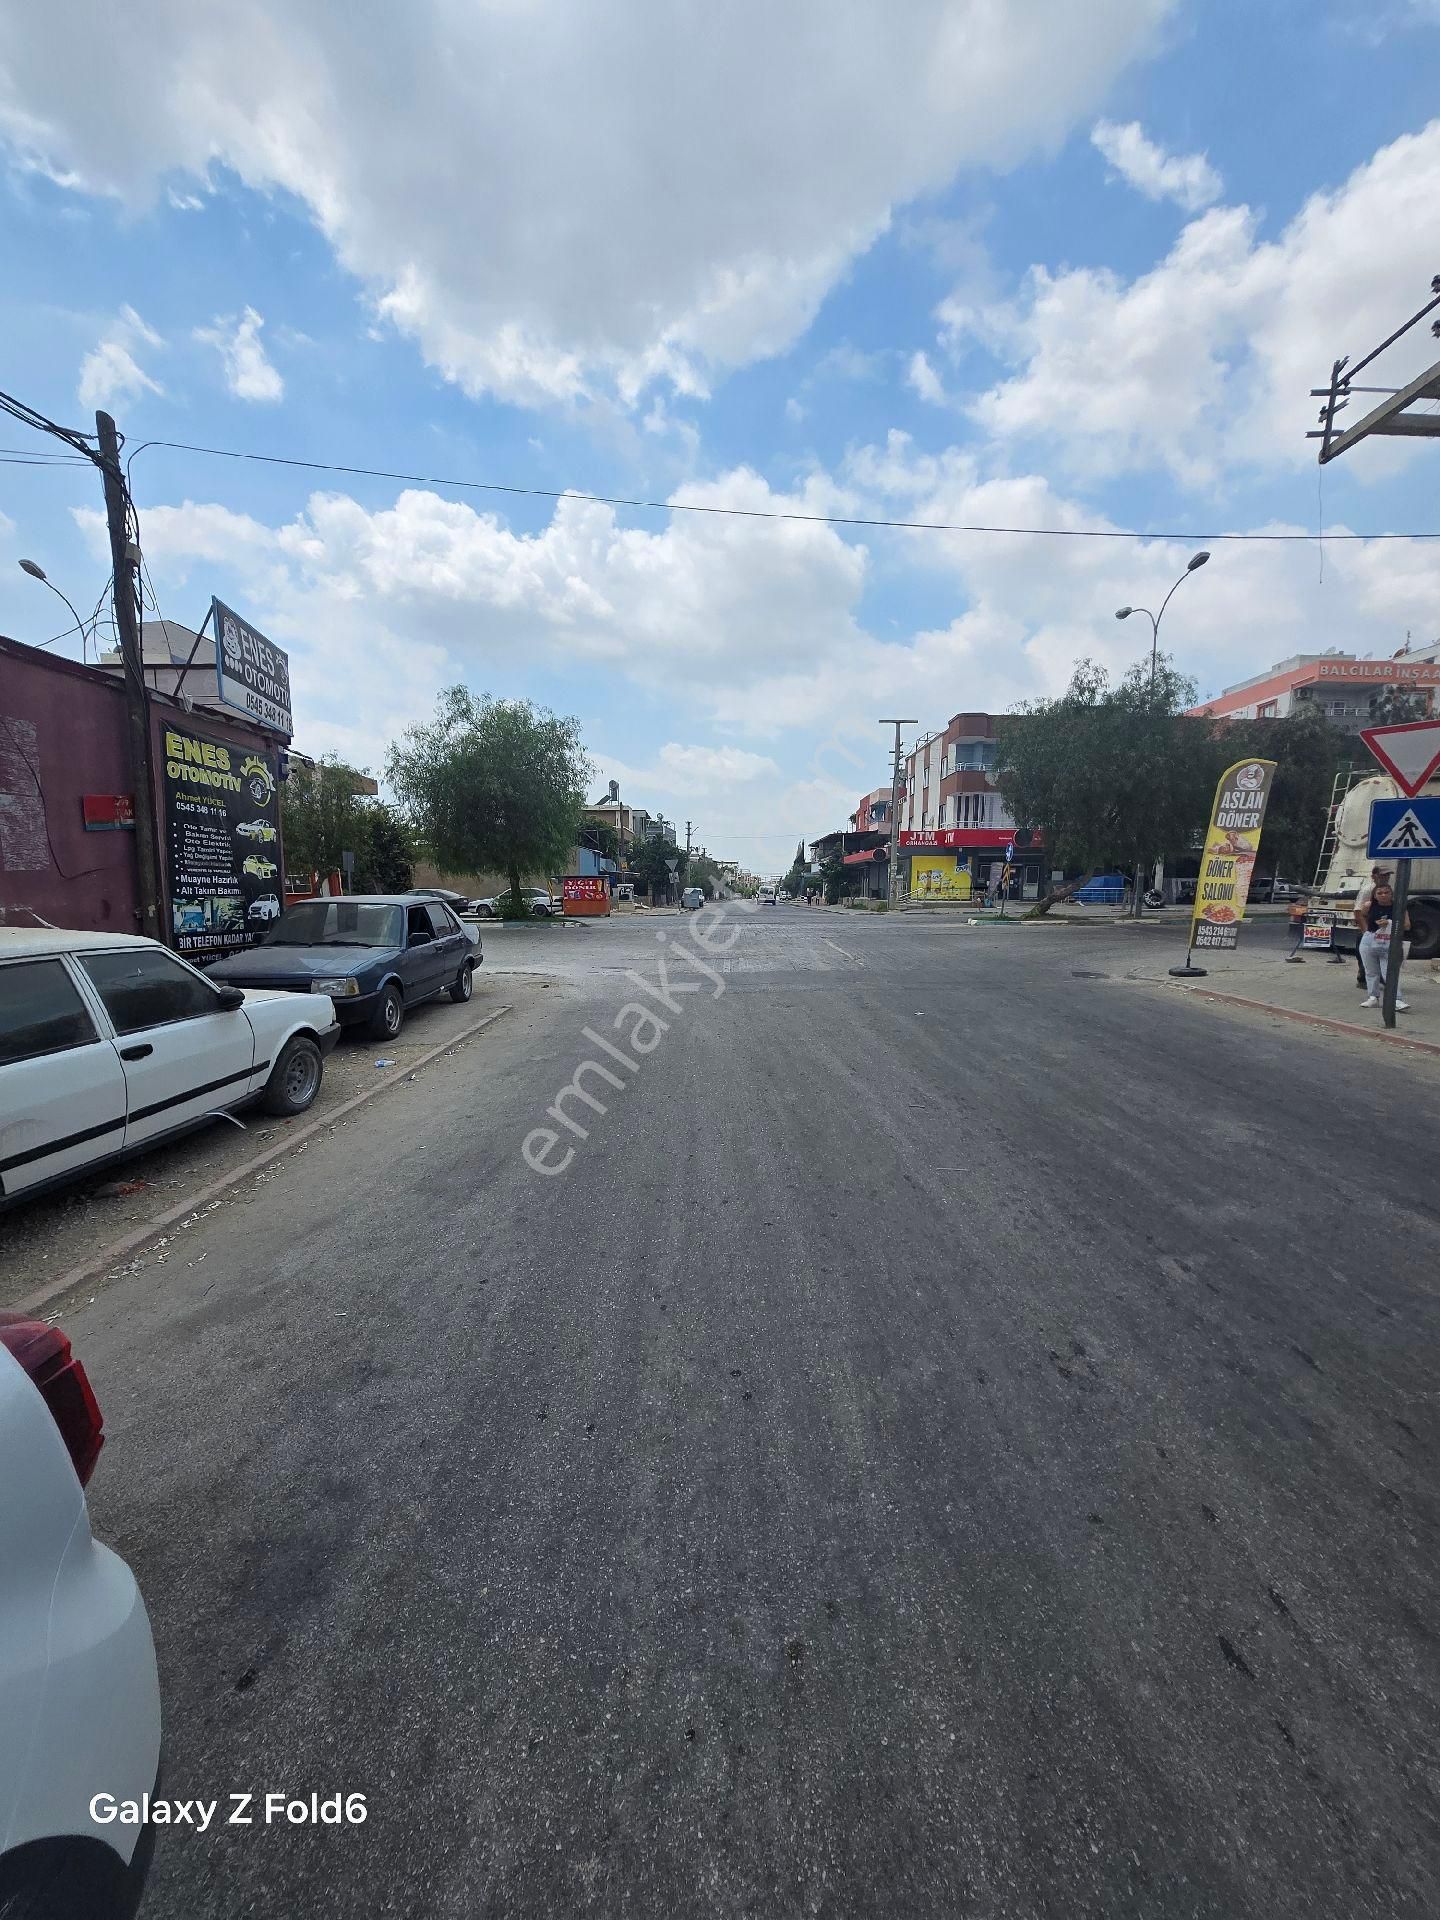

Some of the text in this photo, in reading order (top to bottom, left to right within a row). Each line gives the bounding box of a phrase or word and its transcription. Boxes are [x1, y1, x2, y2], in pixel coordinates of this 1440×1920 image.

[240, 626, 275, 677] ENES
[246, 692, 263, 715] 0545
[277, 709, 285, 727] 11
[165, 731, 231, 771] ENES
[166, 760, 242, 793] OTOMOTİV
[175, 792, 226, 807] Ahmet YÜCEL
[1220, 791, 1265, 809] ASLAN
[176, 802, 195, 812] 0545
[210, 807, 217, 816] 11
[1216, 810, 1260, 828] DÖNER
[910, 831, 936, 841] JTM
[1206, 856, 1234, 878] DÖNER
[180, 886, 193, 895] Alt
[1202, 882, 1234, 901] SALONU
[178, 935, 192, 949] BİR
[192, 935, 222, 948] TELEFON
[223, 933, 244, 945] KADAR
